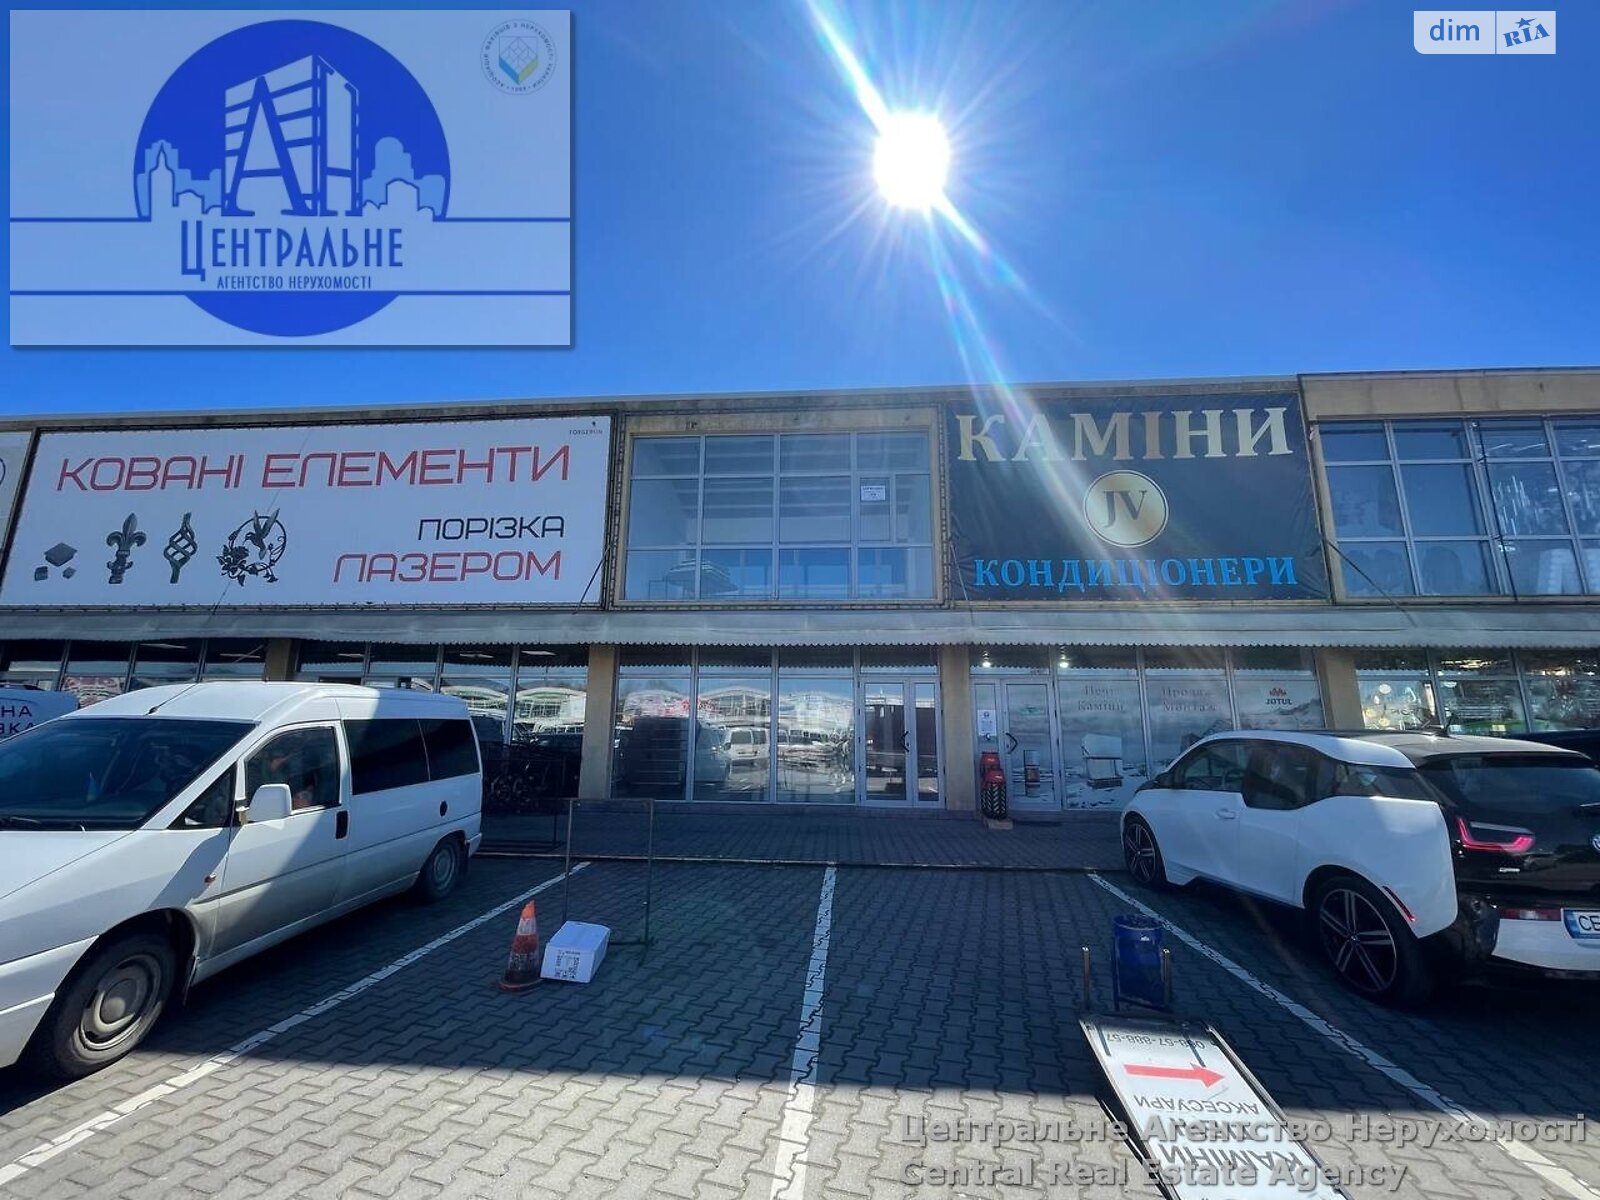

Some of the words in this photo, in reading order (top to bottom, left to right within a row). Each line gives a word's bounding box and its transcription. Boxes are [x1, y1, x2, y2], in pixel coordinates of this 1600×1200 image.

[957, 406, 1294, 463] КАМІНИ
[57, 453, 245, 492] КОВАНІ
[262, 445, 570, 489] ЕЛЕМЕНТИ
[1101, 489, 1149, 528] JV
[418, 516, 565, 540] ПОРІЗКА
[333, 551, 561, 583] ЛАЗЕРОМ
[974, 556, 1298, 593] КОНДИЦІОНЕРИ
[1133, 1095, 1260, 1115] АКСЕСУАРИ
